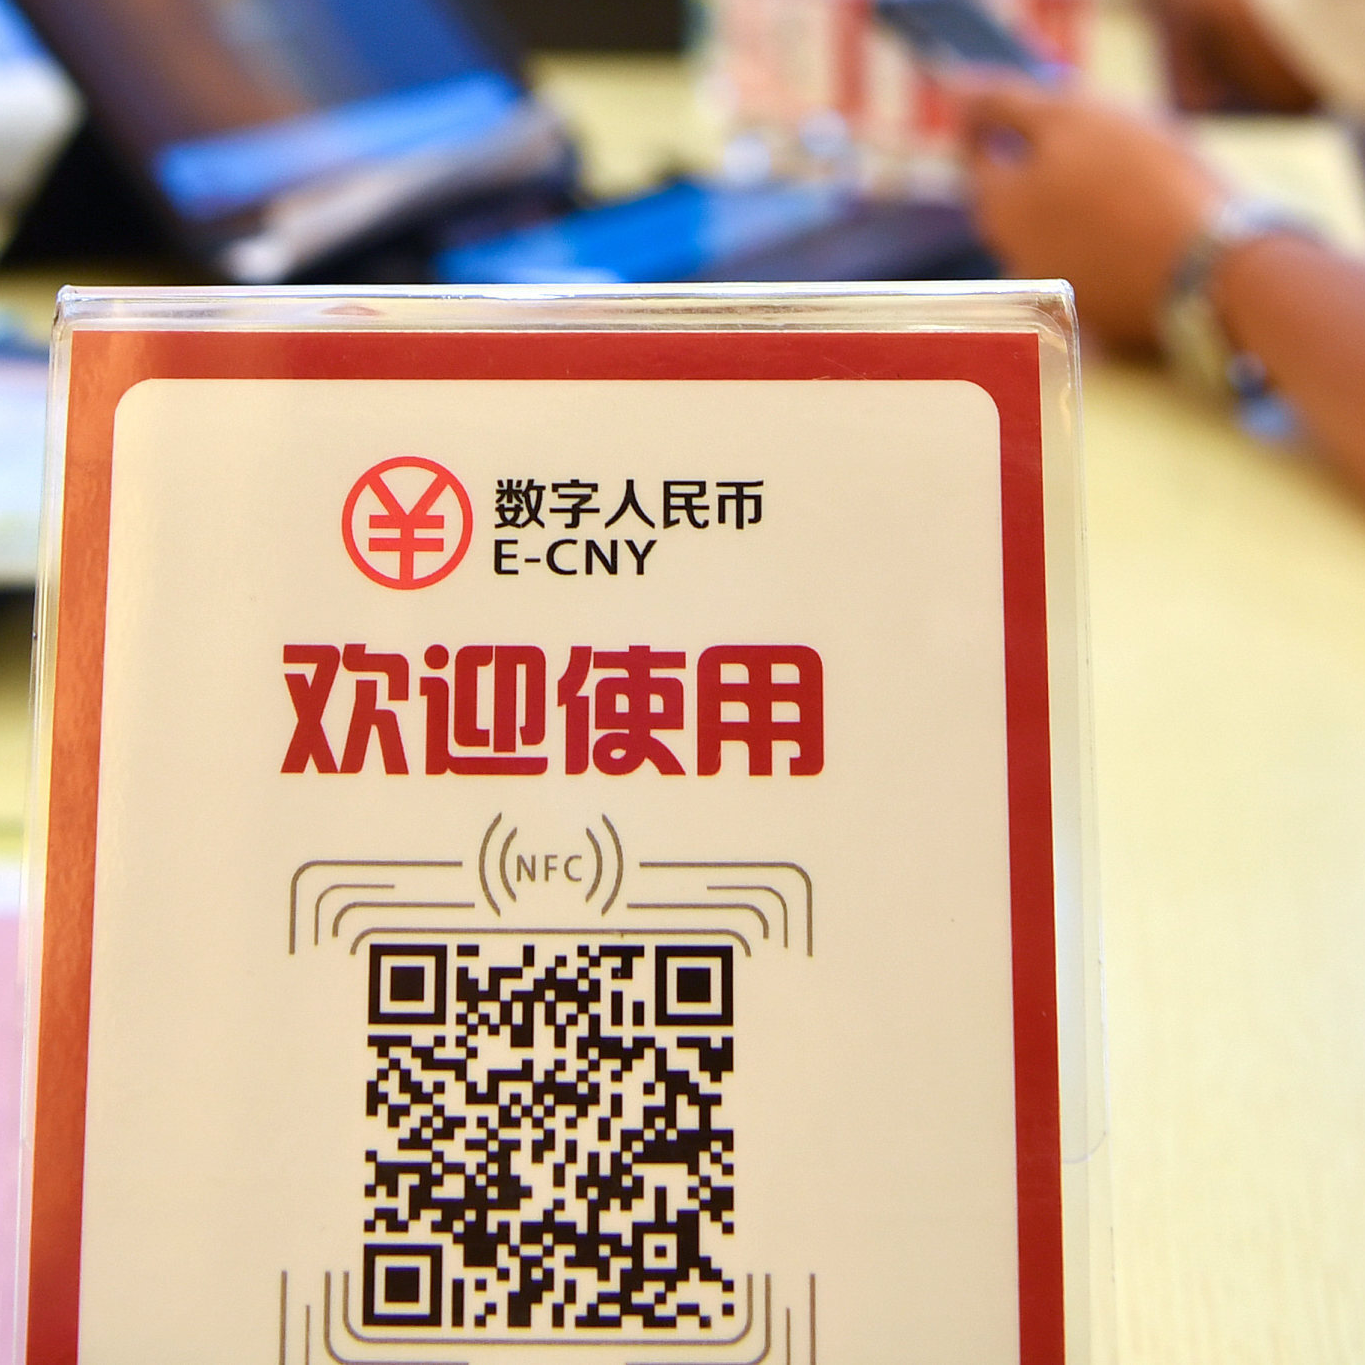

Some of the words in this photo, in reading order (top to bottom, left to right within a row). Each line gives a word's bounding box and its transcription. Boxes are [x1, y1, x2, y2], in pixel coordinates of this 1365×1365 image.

[493, 478, 766, 533] 数字人民币
[493, 538, 660, 579] E-CNY
[280, 643, 826, 778] 欢迎使用
[515, 853, 584, 884] NFC
